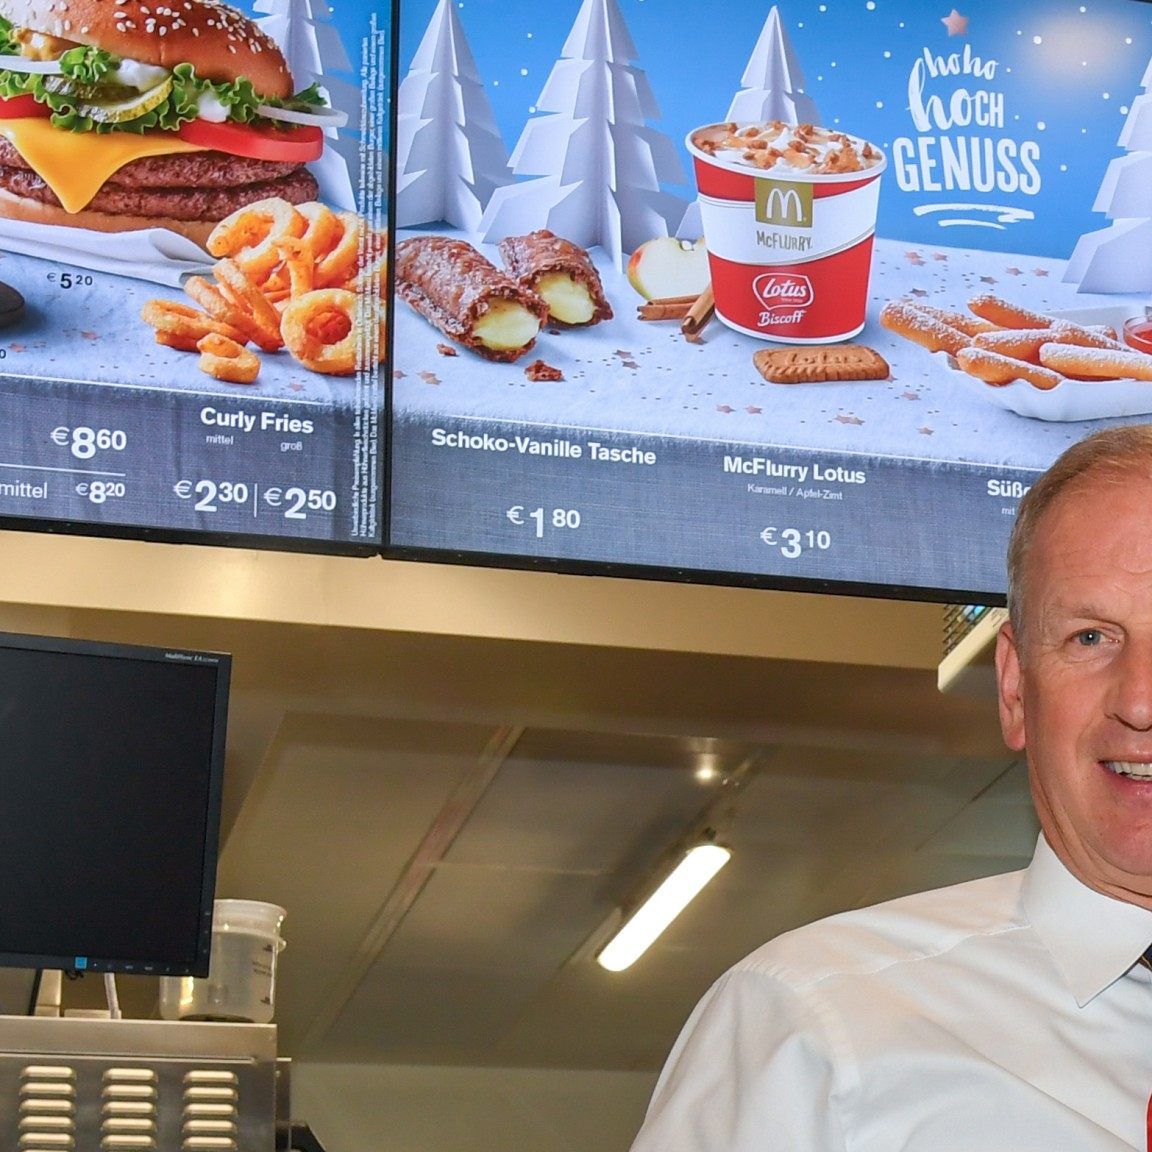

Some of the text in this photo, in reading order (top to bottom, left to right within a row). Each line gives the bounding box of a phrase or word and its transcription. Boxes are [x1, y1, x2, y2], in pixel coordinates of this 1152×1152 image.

[923, 43, 999, 81] hoho
[892, 136, 1041, 195] GENUSS
[763, 278, 807, 298] Lotus
[757, 309, 807, 327] Biscoff
[200, 406, 314, 434] Curly Fries
[205, 433, 234, 446] mittel
[280, 439, 303, 452] groß
[431, 428, 657, 466] Schoko-Vanille Tasche
[723, 455, 866, 485] McFlurry Lotus
[0, 480, 48, 499] mittel
[747, 483, 787, 496] Karamell
